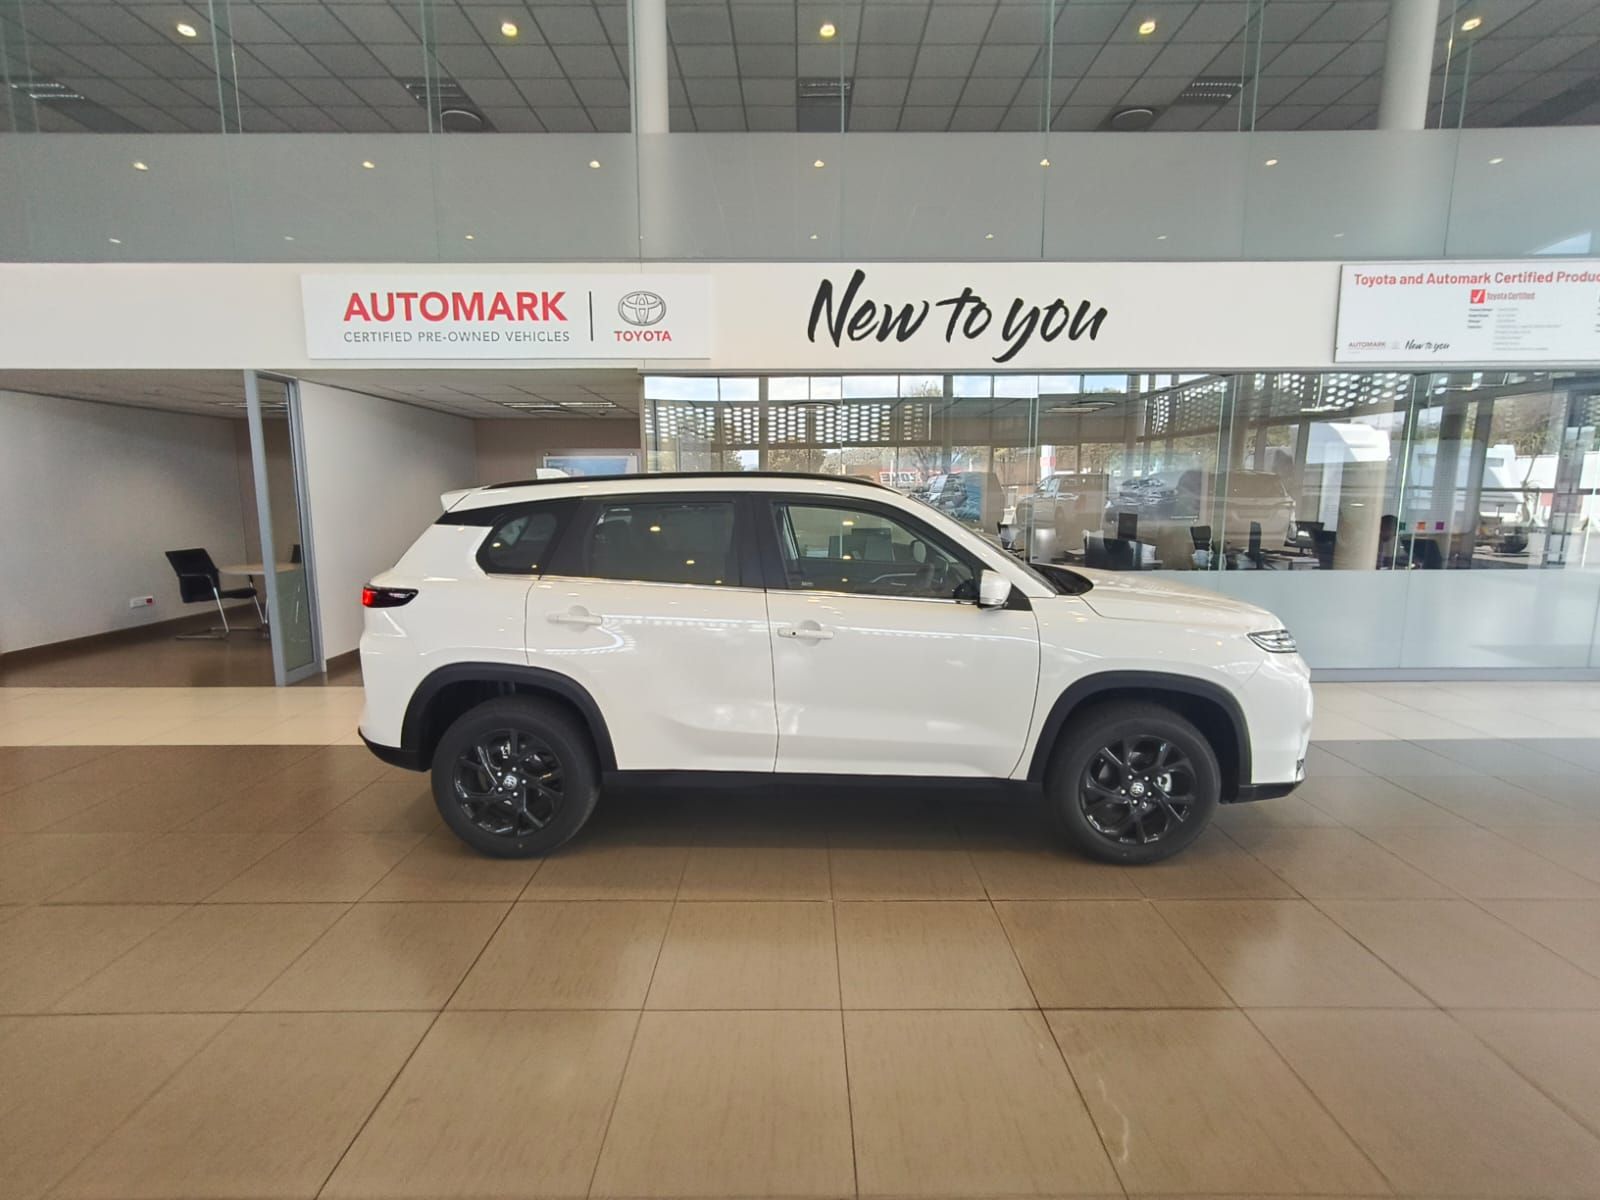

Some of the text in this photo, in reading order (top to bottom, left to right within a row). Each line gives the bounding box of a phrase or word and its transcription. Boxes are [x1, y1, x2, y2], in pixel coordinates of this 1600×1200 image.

[1354, 273, 1397, 287] Toyota
[1399, 273, 1423, 285] and
[1426, 272, 1491, 285] Automark
[1494, 271, 1553, 284] Certified
[1487, 291, 1536, 301] Toyota Certified
[343, 291, 568, 322] AUTOMARK
[807, 268, 1108, 364] New to you
[343, 331, 570, 343] CERTIFIED PRE-OWNED VEHICLES
[614, 330, 672, 342] TOYOTA
[1405, 339, 1423, 350] New
[1424, 342, 1432, 350] to
[1432, 343, 1450, 353] you
